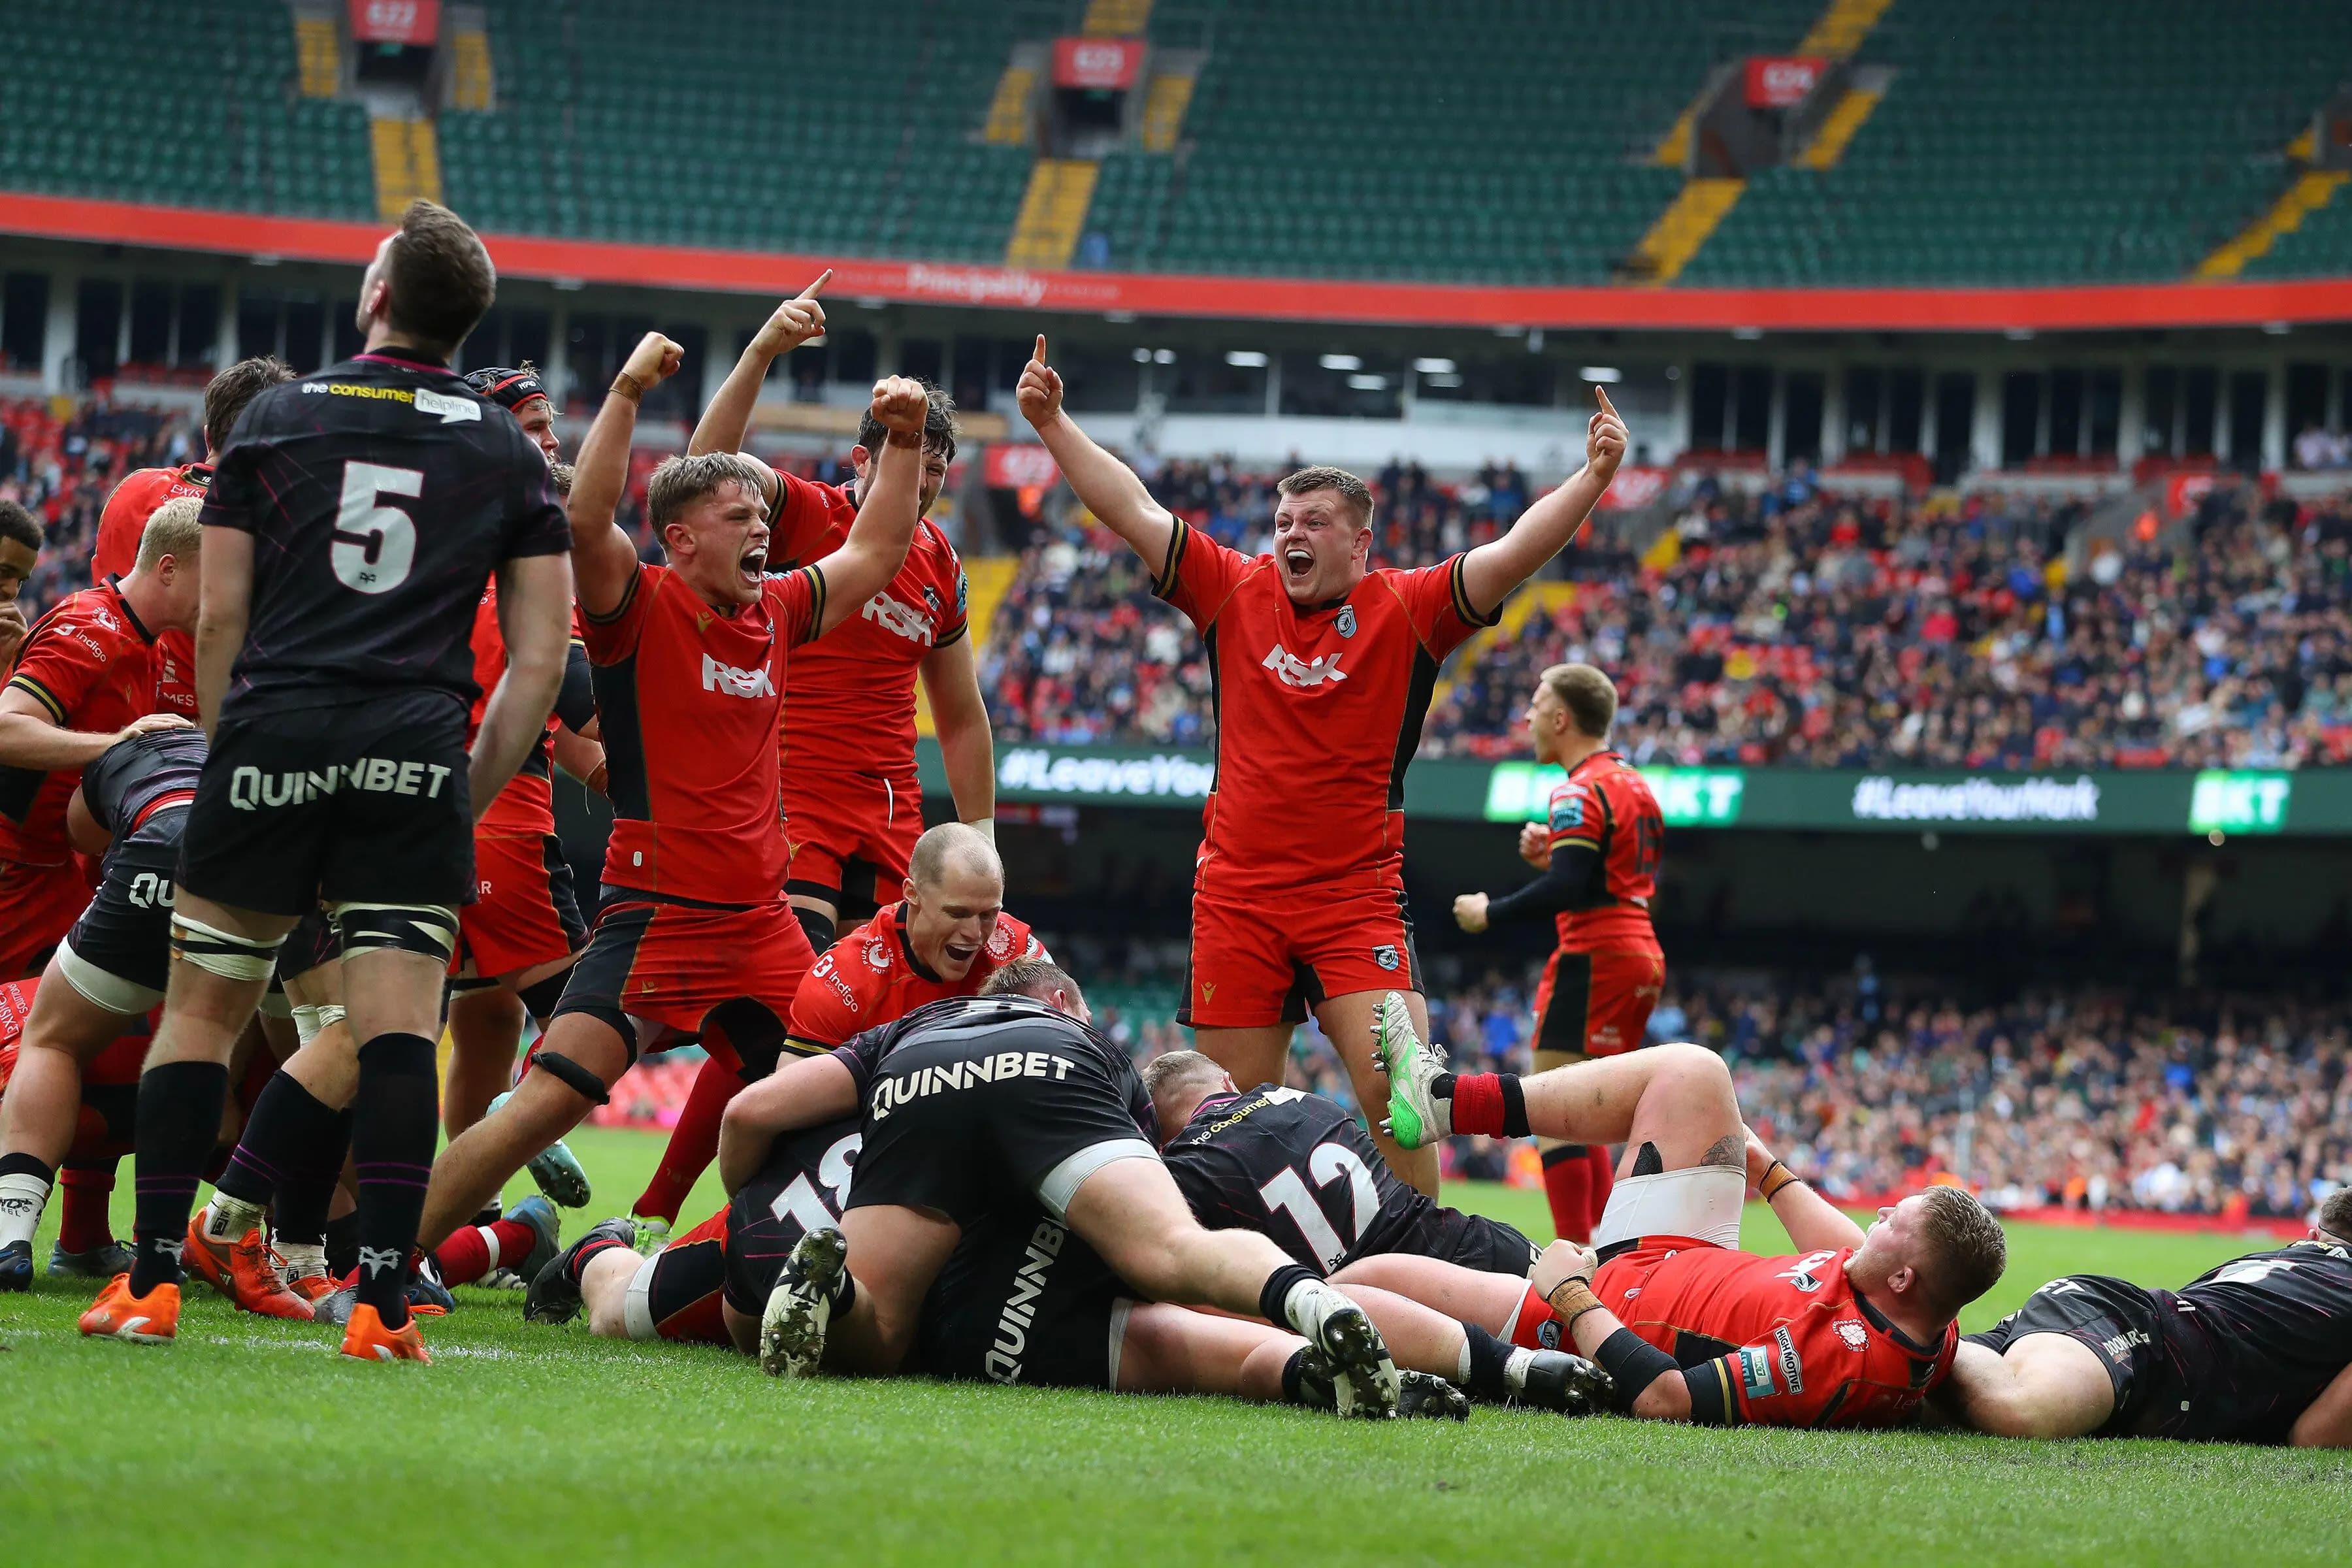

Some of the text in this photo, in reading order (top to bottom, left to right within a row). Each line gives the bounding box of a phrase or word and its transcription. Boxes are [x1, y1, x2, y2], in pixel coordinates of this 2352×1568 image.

[302, 383, 478, 416] the consumer helpline
[331, 459, 424, 594] 5
[861, 591, 932, 647] RSK
[75, 628, 108, 663] Indigo
[1262, 644, 1348, 687] RSK
[702, 653, 776, 698] RSK
[230, 757, 452, 811] QUINNBET
[2196, 779, 2288, 825] BKT
[999, 920, 1017, 938] TECH
[829, 970, 858, 1013] Indigo
[871, 1051, 1075, 1121] QUINNBET
[1210, 1095, 1270, 1134] consumer
[1257, 1141, 1381, 1276] 12
[1754, 1356, 1765, 1377] BKT
[1776, 1330, 1803, 1392] HIGH MOTIVE
